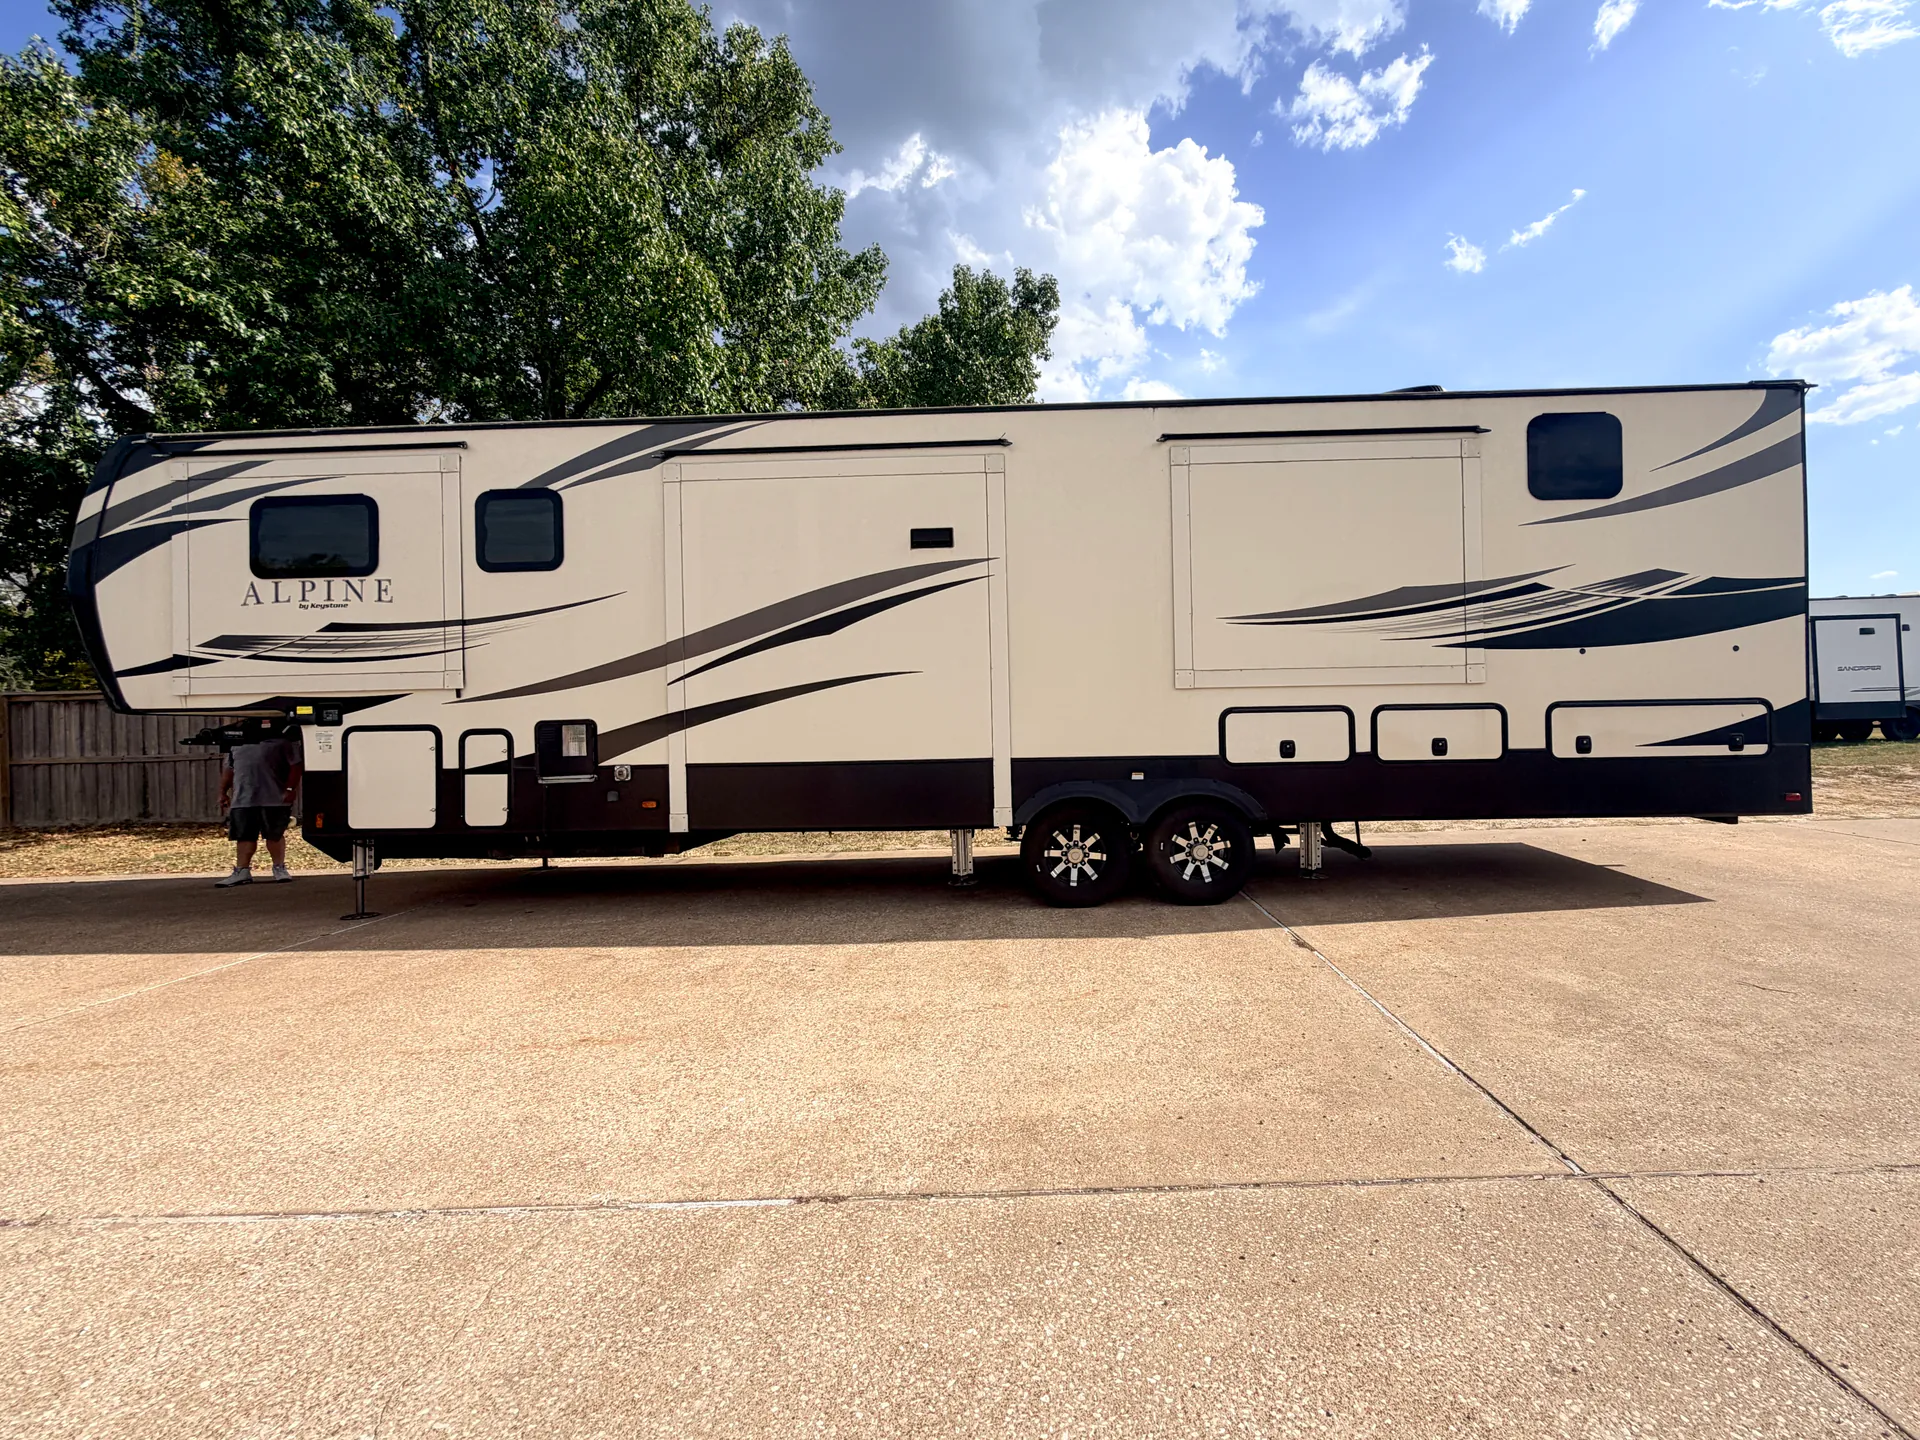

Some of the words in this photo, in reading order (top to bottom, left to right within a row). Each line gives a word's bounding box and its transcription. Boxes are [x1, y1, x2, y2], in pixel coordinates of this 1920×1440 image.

[240, 578, 394, 607] ALPINE
[298, 602, 309, 610] by
[310, 602, 349, 610] Keystone
